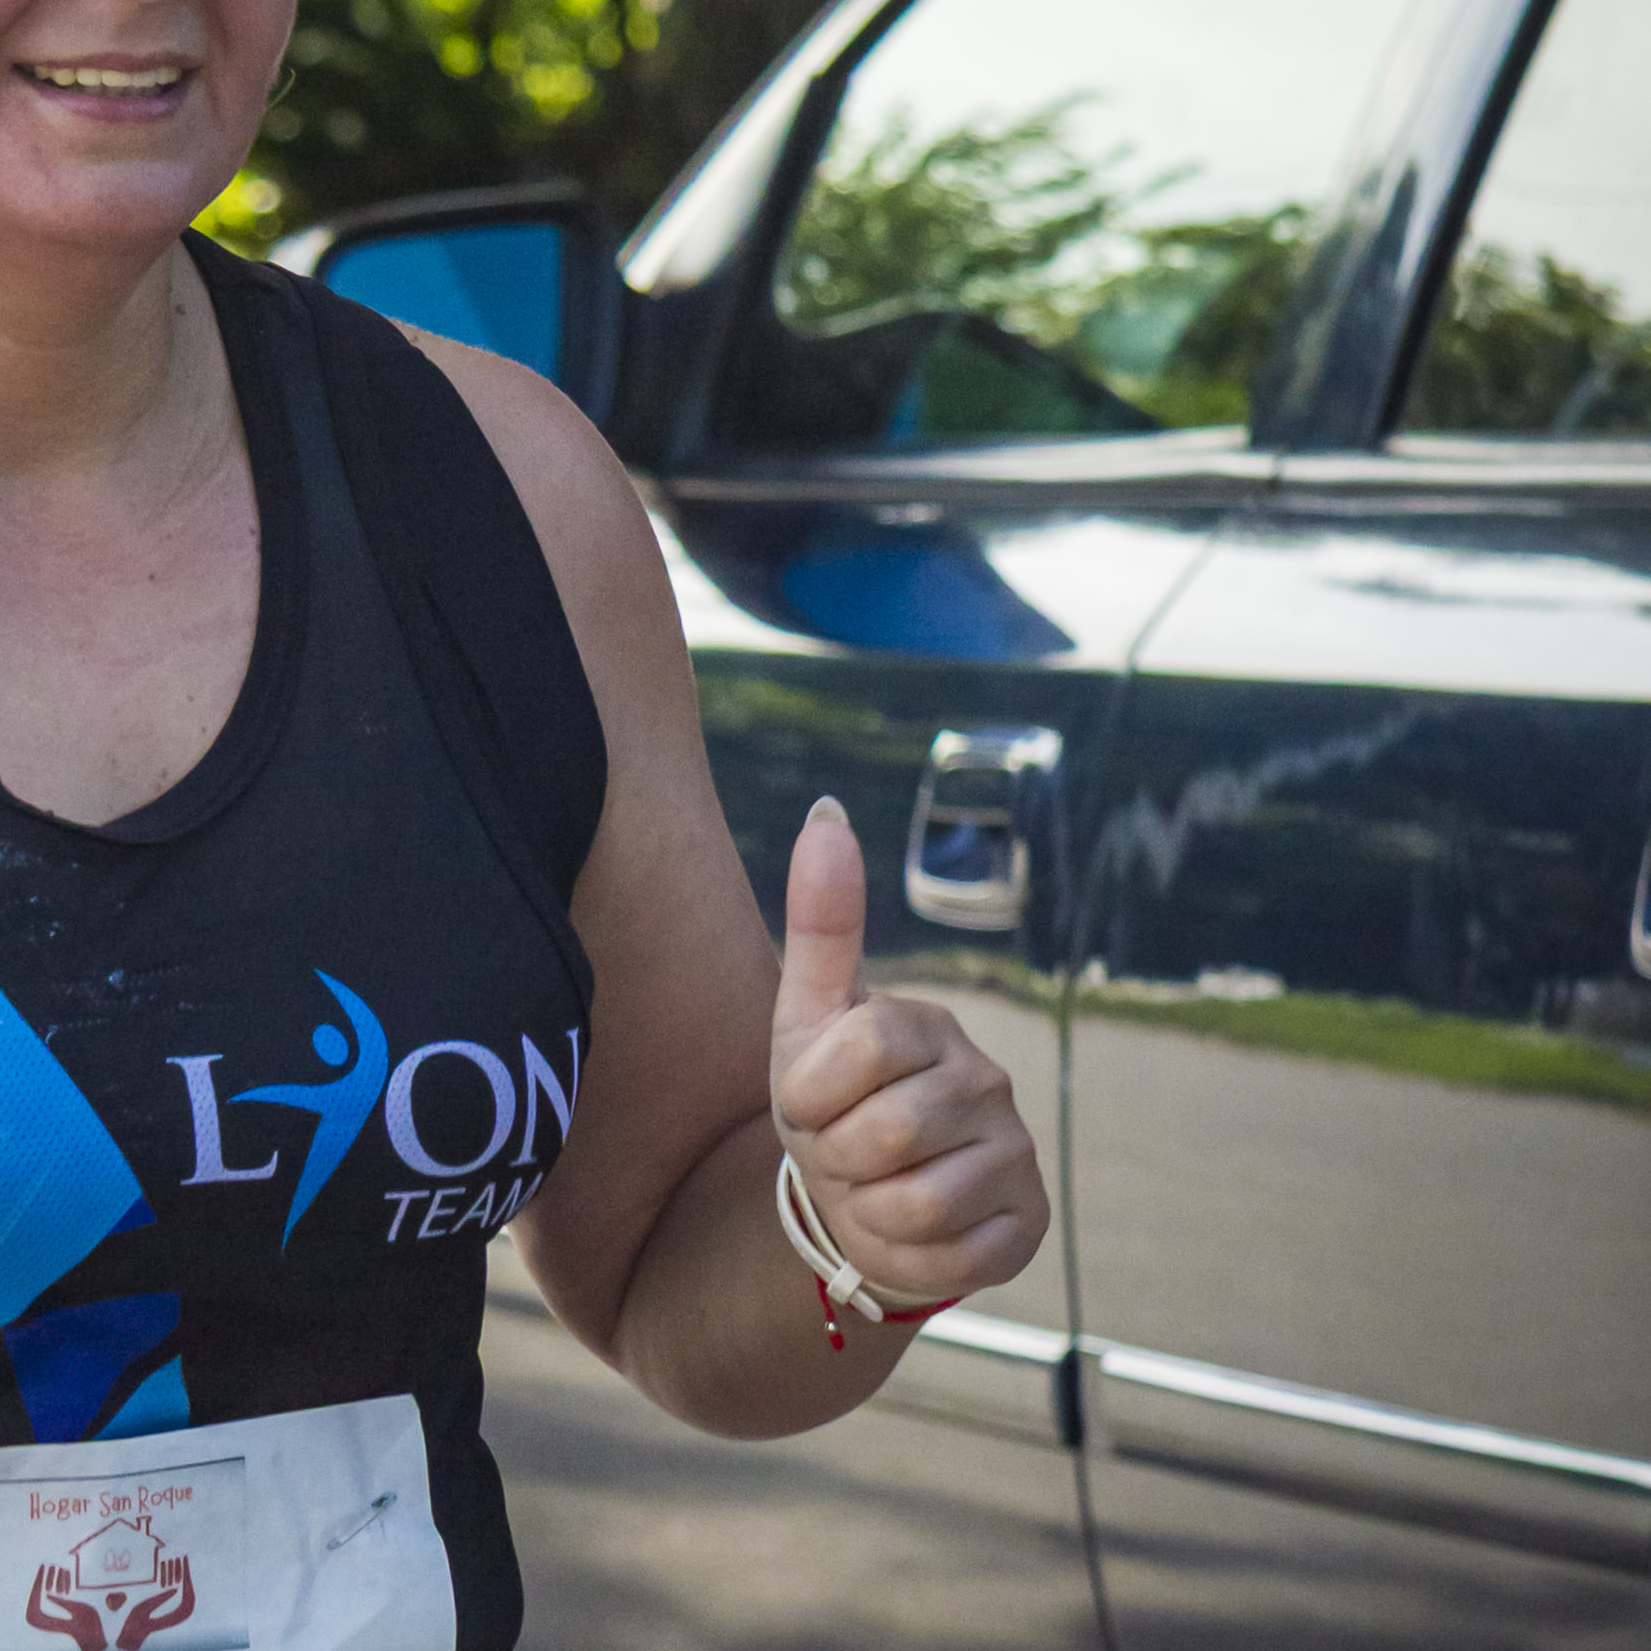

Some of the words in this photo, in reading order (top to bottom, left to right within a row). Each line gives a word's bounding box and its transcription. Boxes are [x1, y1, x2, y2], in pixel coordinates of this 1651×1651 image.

[29, 1491, 91, 1522] Hogar
[99, 1490, 132, 1518] San
[137, 1485, 194, 1514] Roque
